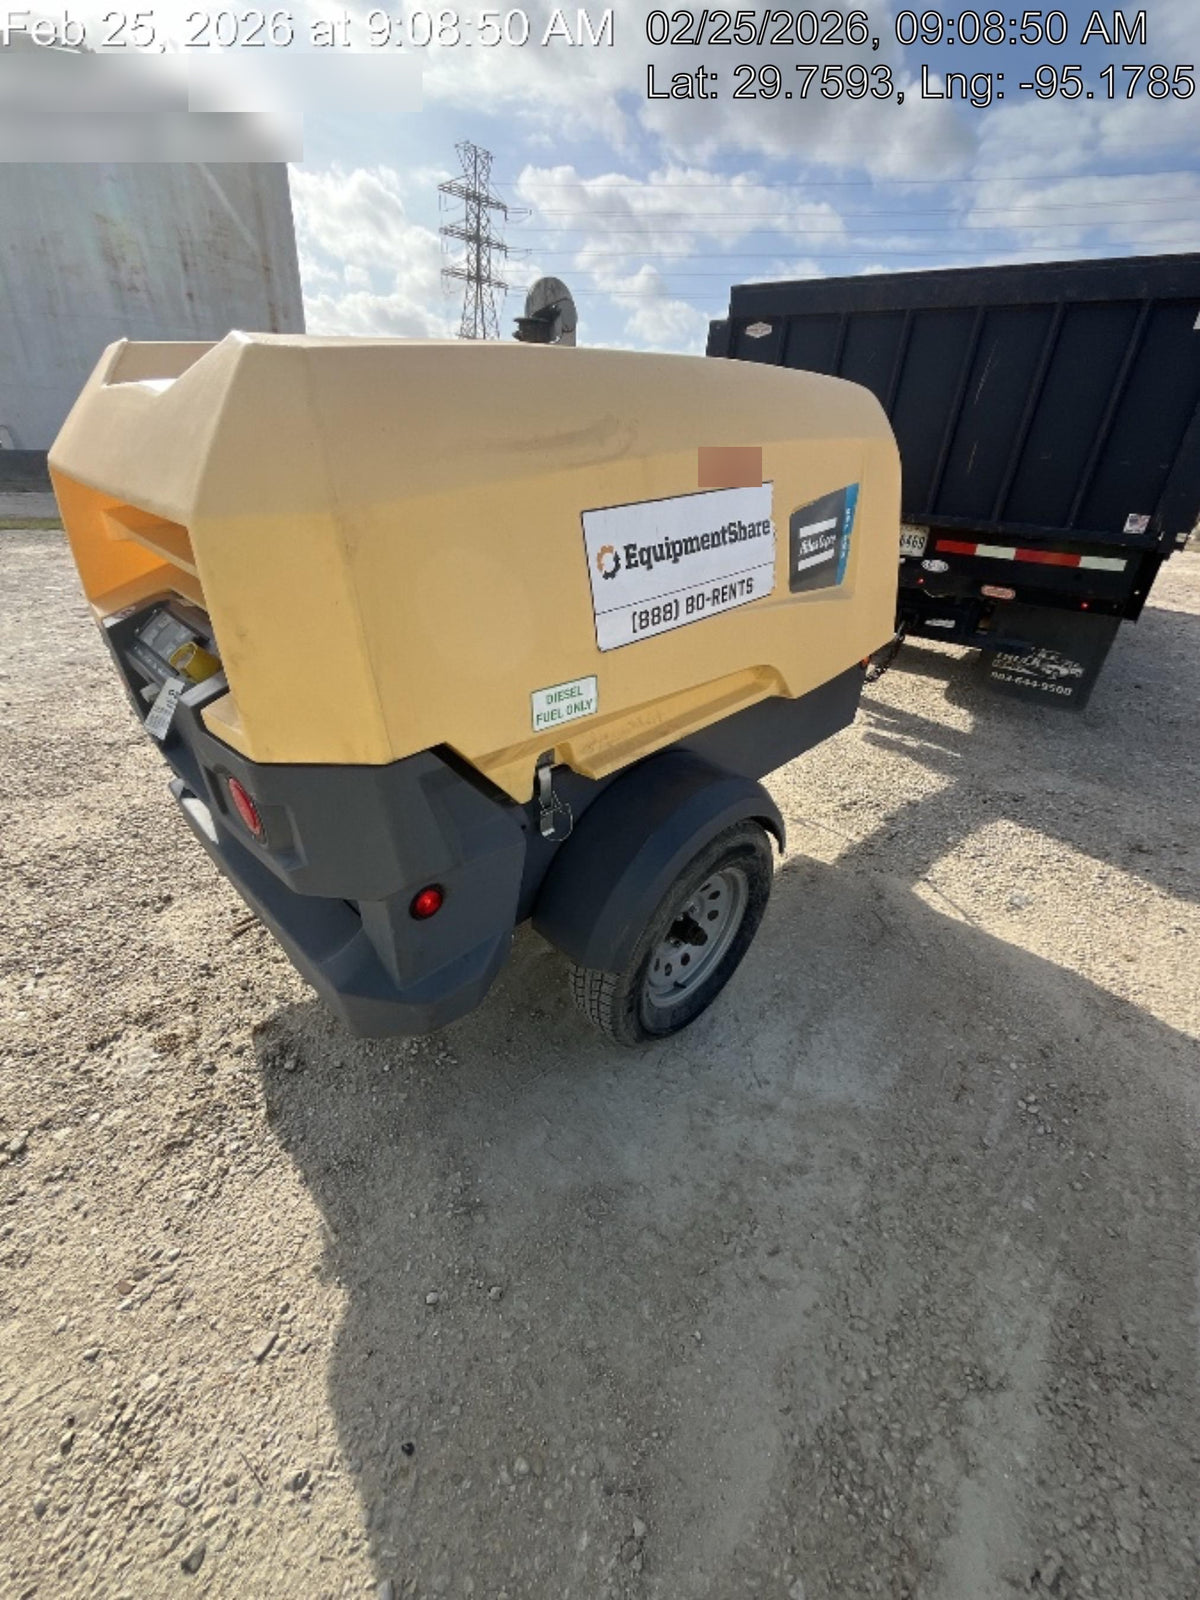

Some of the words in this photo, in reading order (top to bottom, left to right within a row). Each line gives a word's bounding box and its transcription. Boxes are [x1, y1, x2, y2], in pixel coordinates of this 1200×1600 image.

[623, 518, 771, 571] EquipmentShare
[632, 598, 680, 634] (888)
[545, 685, 584, 705] DIESEL
[536, 708, 564, 726] FUEL
[566, 698, 593, 716] ONLY
